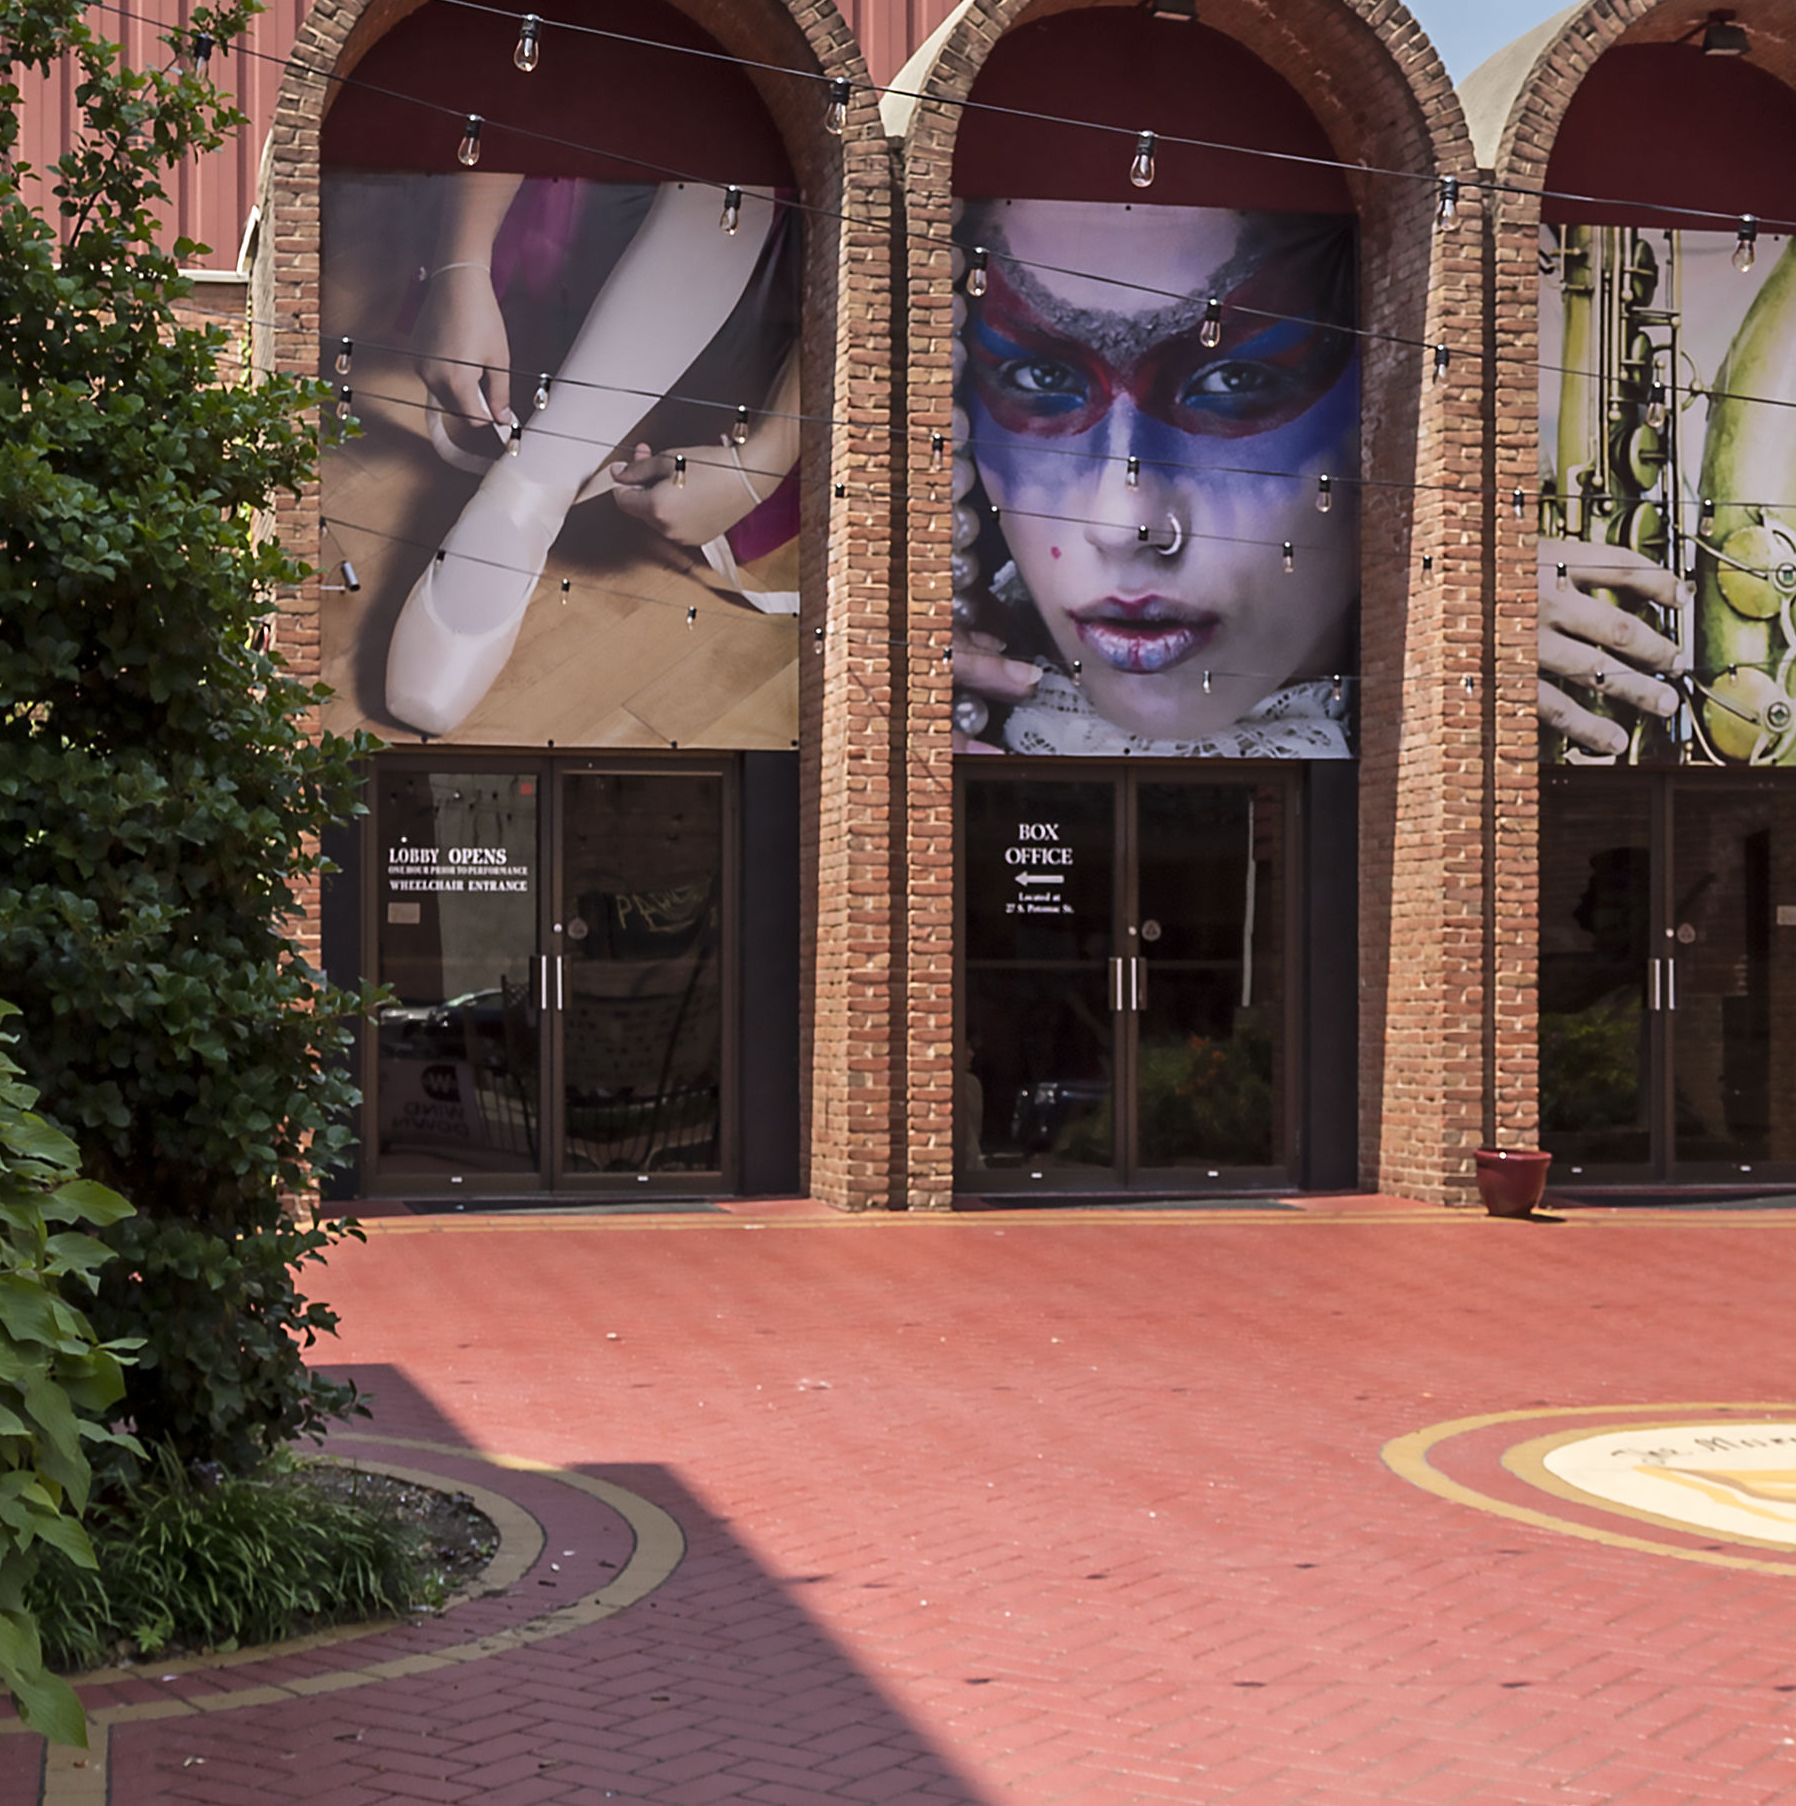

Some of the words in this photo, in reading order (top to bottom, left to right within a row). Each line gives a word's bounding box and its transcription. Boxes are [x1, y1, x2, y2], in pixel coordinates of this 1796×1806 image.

[1018, 823, 1060, 841] BOX
[388, 847, 440, 864] LOBBY
[447, 847, 508, 865] OPENS
[1005, 846, 1074, 865] OFFICE
[388, 865, 405, 875] ONE
[467, 866, 529, 876] PERFORMANCE
[389, 879, 465, 892] WHEELCHAIR
[468, 880, 529, 892] ENTRANCE
